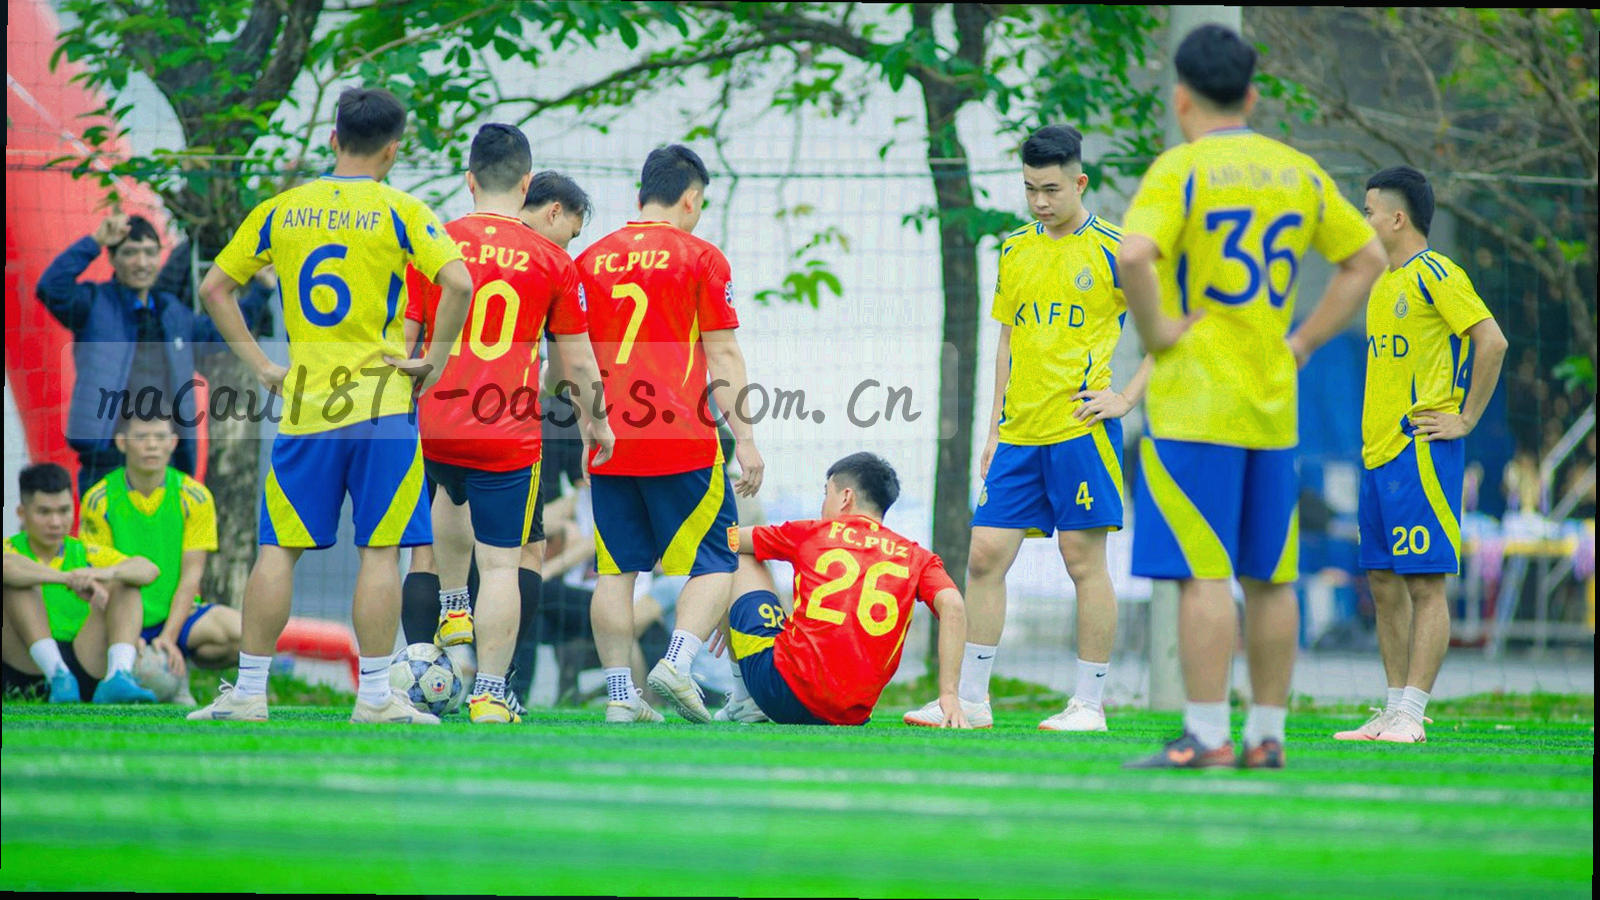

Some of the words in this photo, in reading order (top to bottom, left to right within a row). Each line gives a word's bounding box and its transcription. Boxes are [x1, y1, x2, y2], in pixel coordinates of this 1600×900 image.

[282, 207, 323, 229] ANH
[327, 210, 351, 230] EM
[354, 209, 381, 231] WF
[455, 240, 530, 272] C.PU2
[593, 250, 670, 275] FC.PU2
[1203, 208, 1304, 308] 36
[298, 243, 352, 328] 6
[611, 281, 648, 364] 7
[1075, 481, 1094, 511] 4
[1392, 525, 1431, 556] 20
[804, 548, 910, 637] 26
